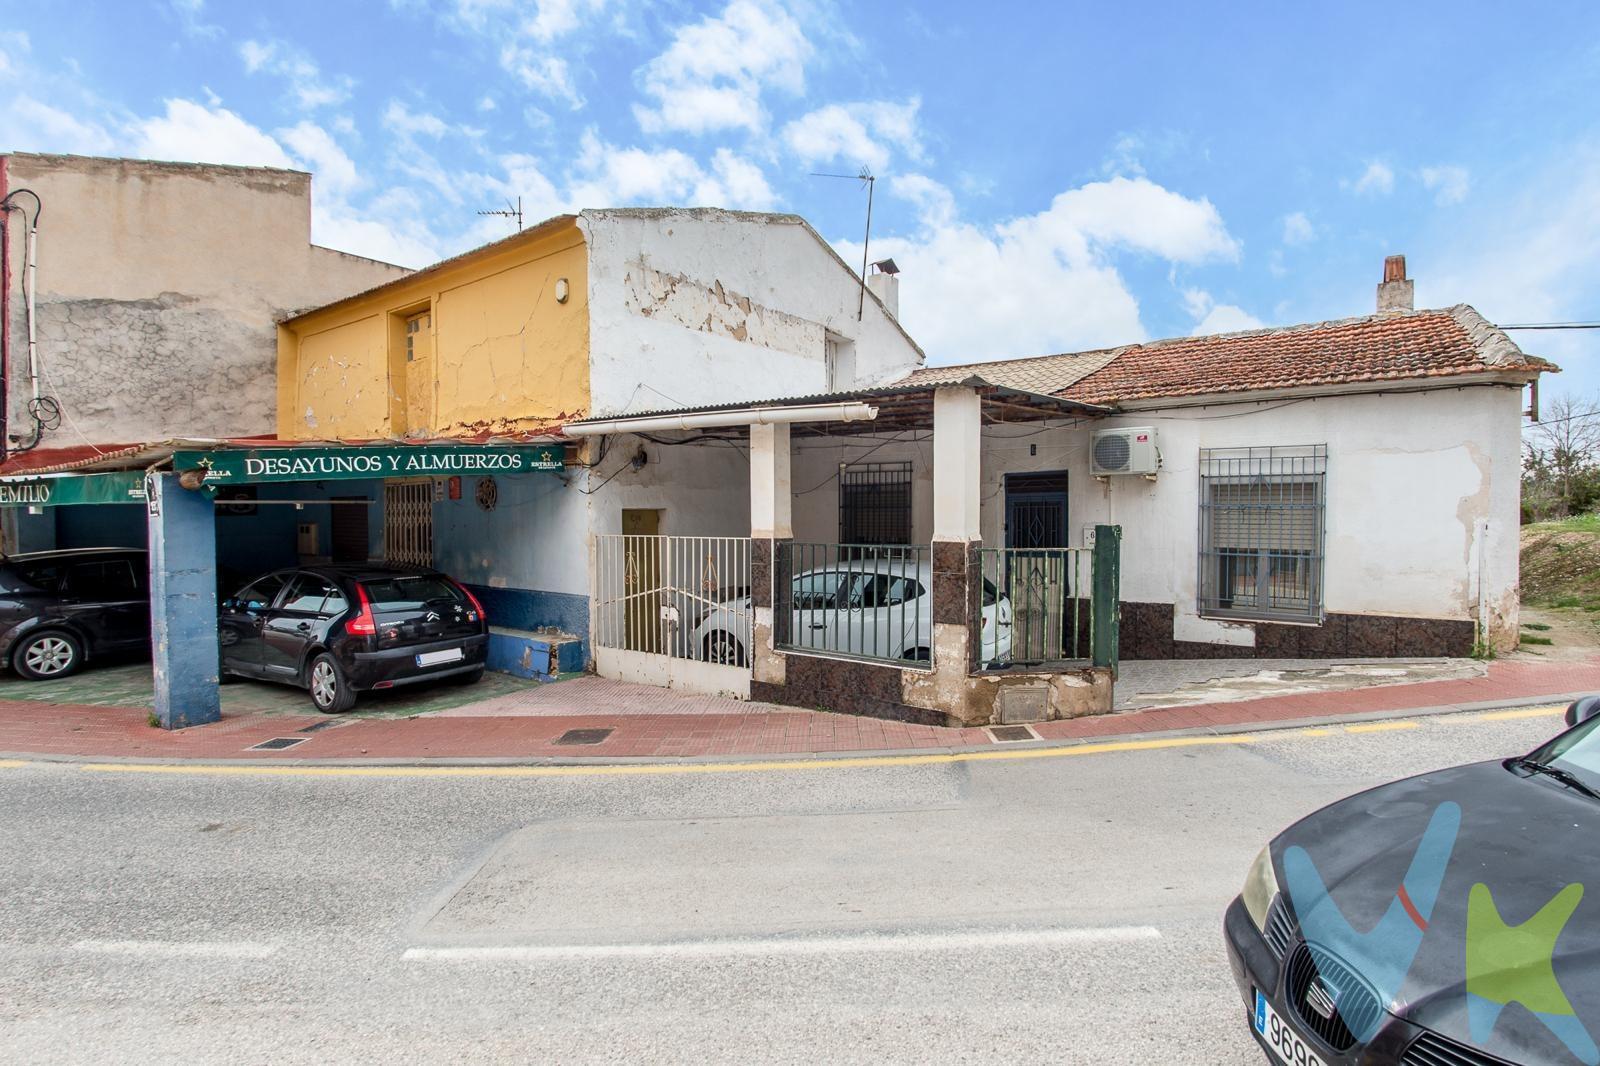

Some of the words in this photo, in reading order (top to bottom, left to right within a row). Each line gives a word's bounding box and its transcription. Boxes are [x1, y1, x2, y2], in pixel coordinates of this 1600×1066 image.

[244, 456, 382, 475] DESAYUNOS
[387, 455, 401, 471] Y
[405, 454, 522, 471] ALMUERZOS
[0, 484, 50, 503] EMILIO
